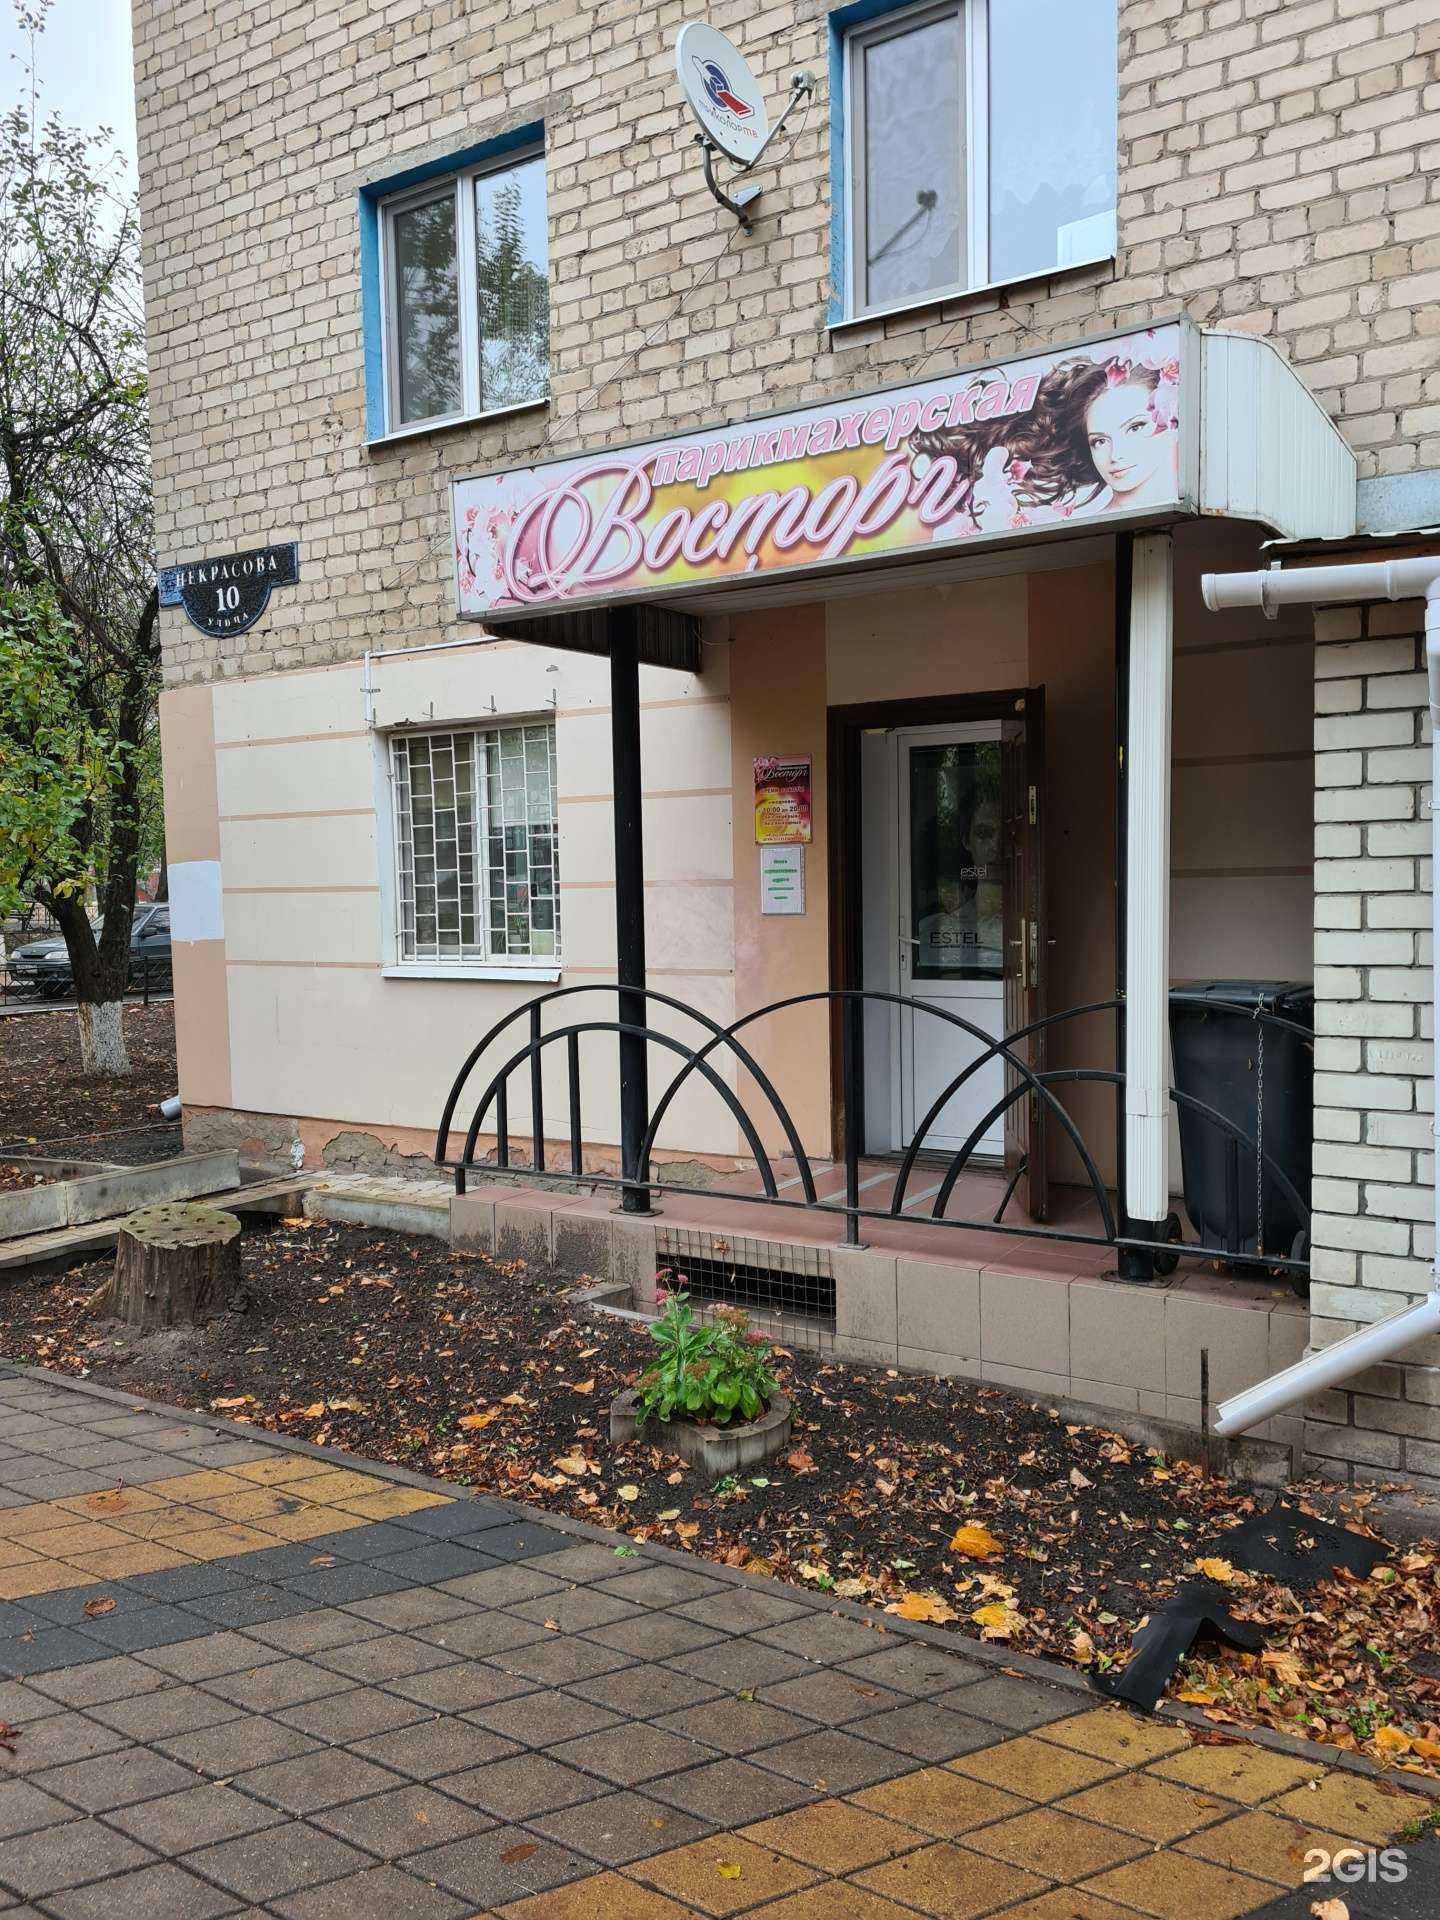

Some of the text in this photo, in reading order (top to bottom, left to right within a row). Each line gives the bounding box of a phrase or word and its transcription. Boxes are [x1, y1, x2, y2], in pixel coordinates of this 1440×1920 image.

[651, 373, 1043, 488] парикмахерская
[504, 445, 970, 602] Восторг
[175, 555, 278, 587] НЕКРАСОВА
[216, 586, 240, 611] 10
[960, 864, 987, 877] estel
[929, 931, 984, 944] ESTEL
